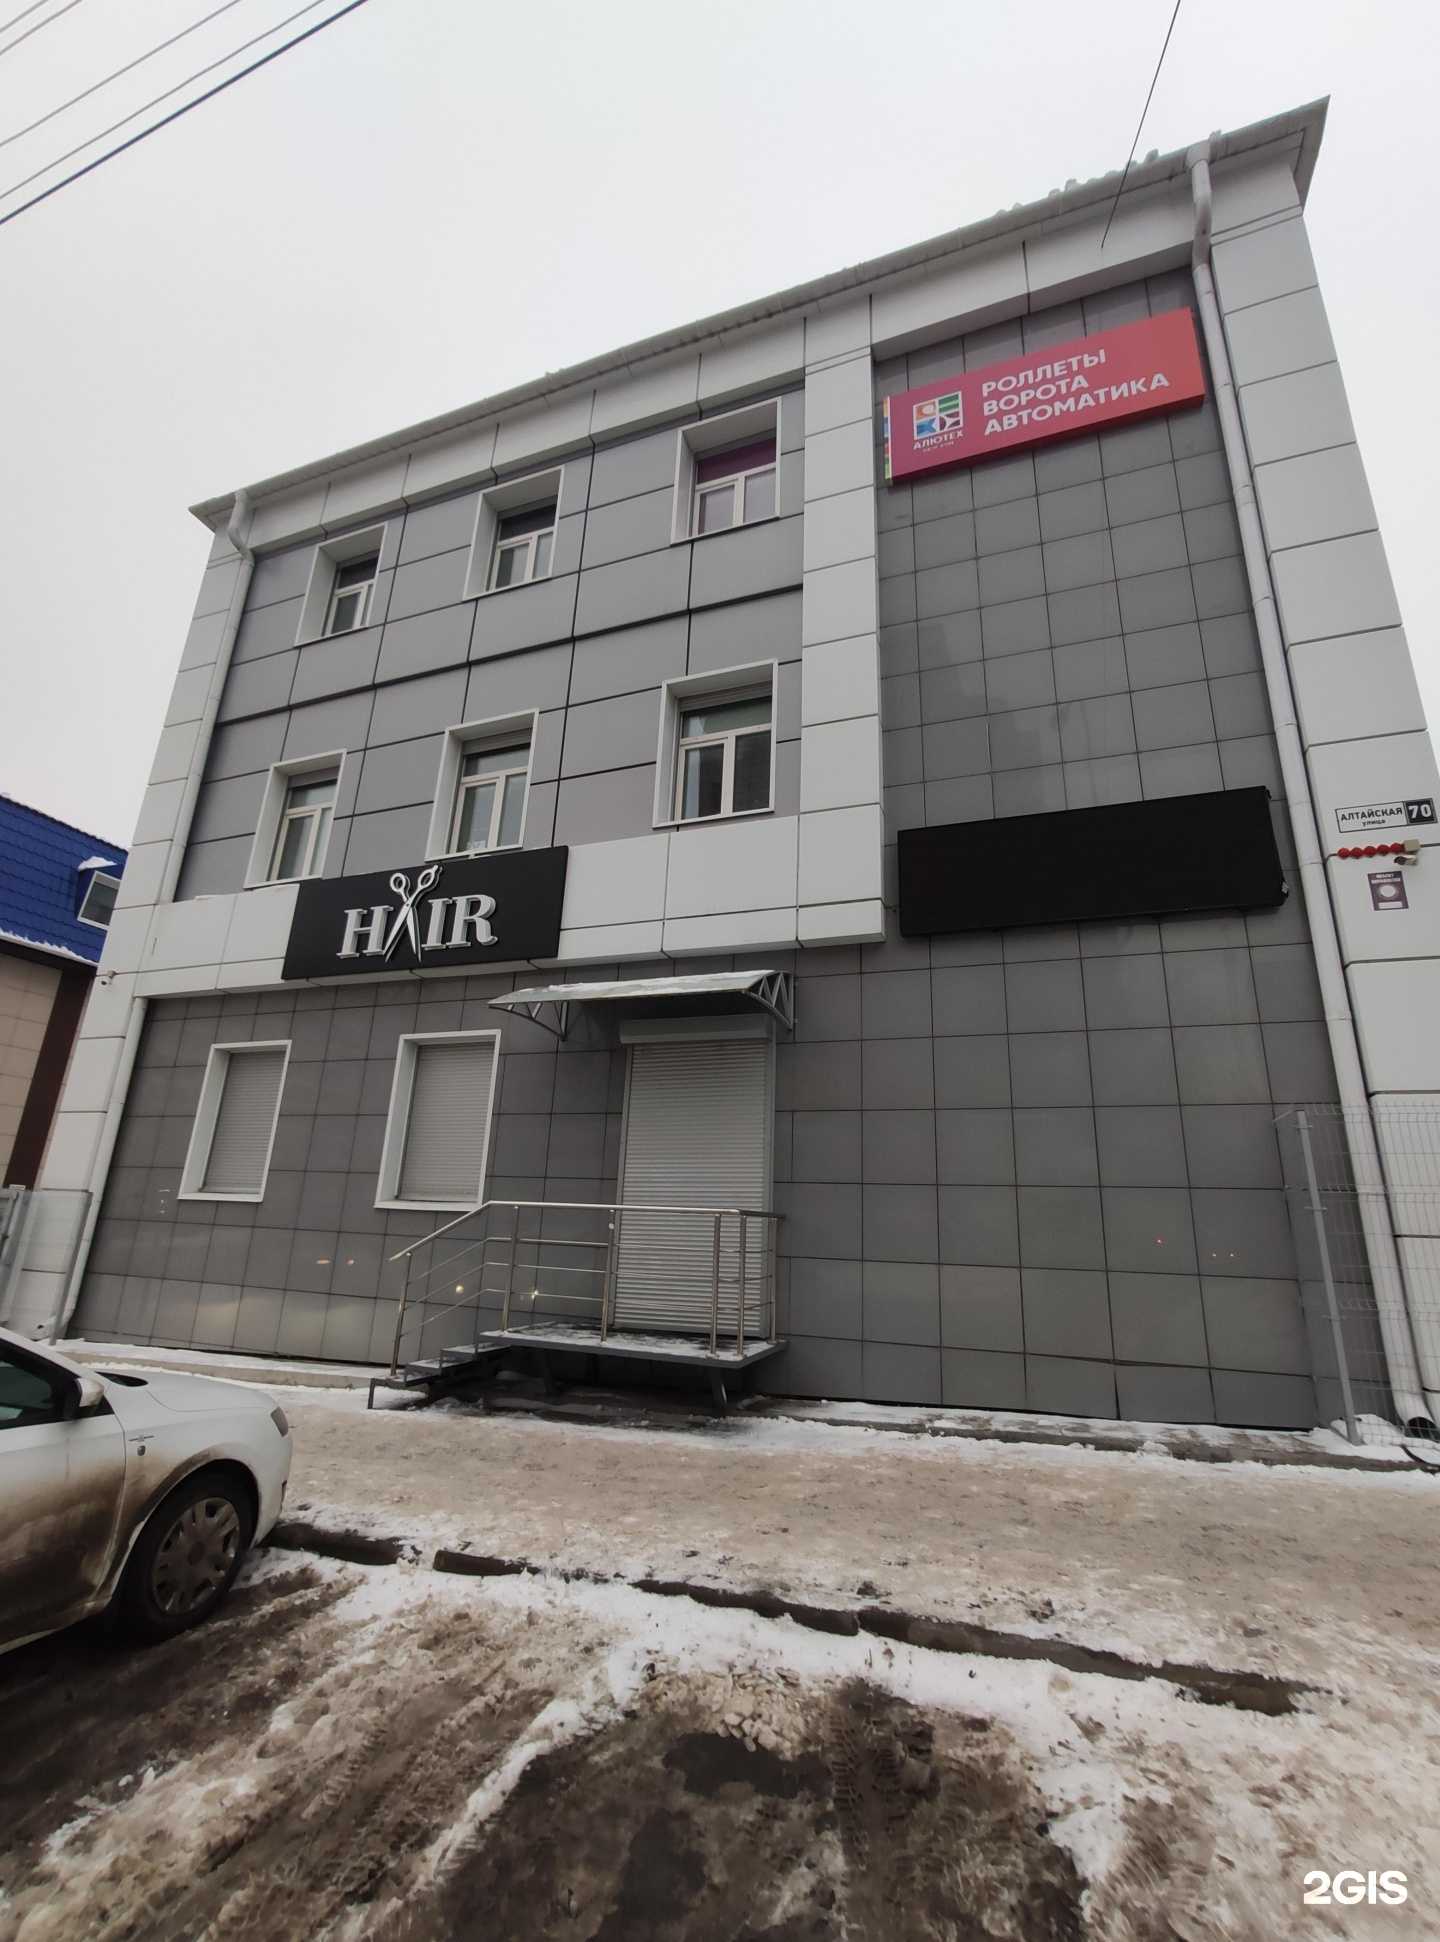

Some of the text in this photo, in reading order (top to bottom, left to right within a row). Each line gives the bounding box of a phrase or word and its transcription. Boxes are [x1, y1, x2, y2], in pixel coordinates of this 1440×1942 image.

[982, 348, 1106, 397] РОЛЛЕТЫ
[983, 375, 1089, 416] ВОРОТА
[984, 373, 1170, 435] АВТОМАТИКА
[1341, 804, 1432, 821] АЛТАЙСКАЯ 70
[336, 865, 498, 963] HAIR
